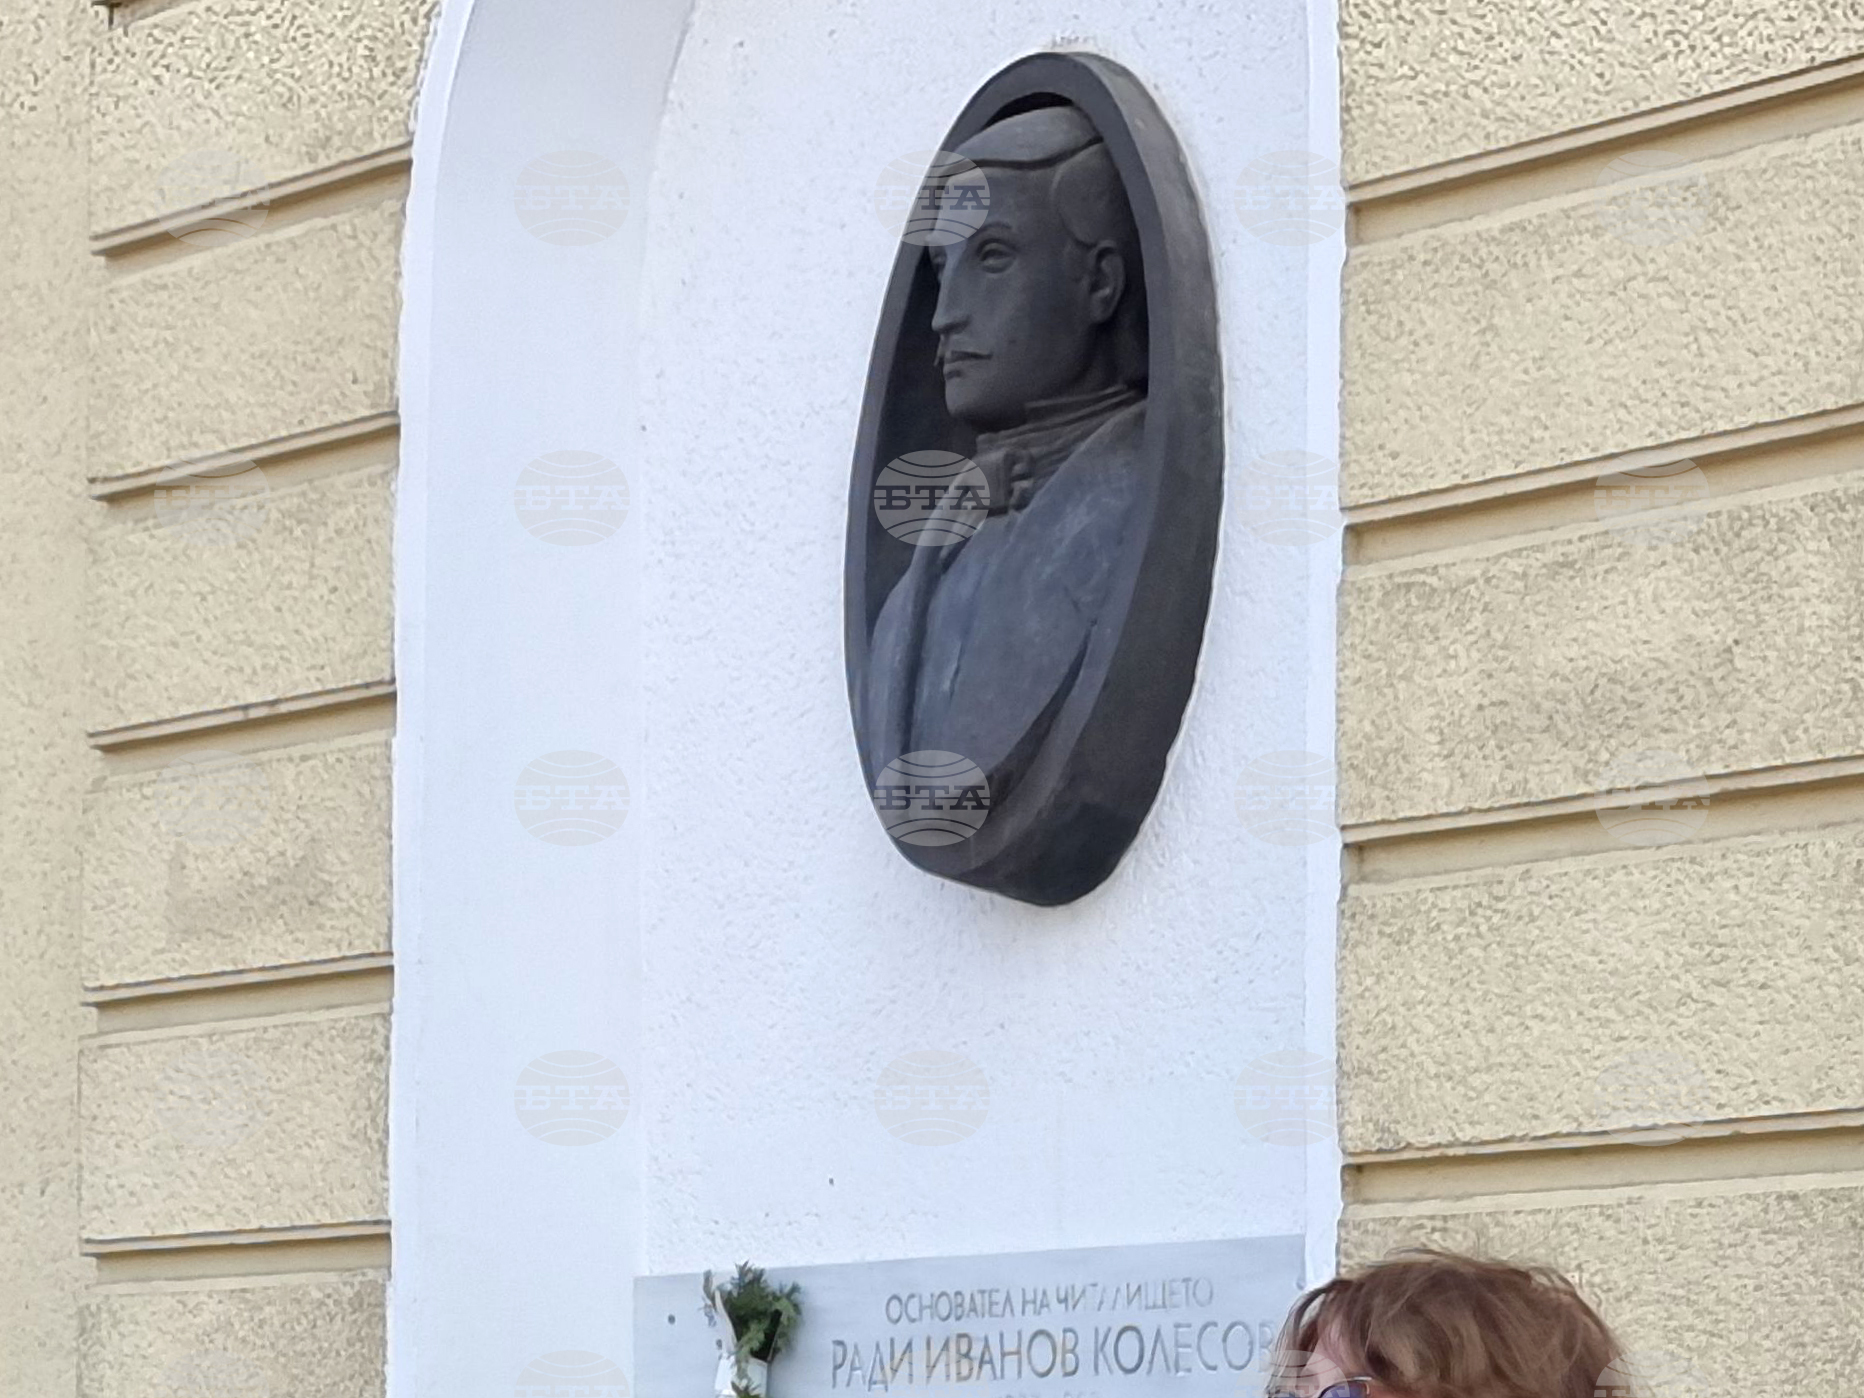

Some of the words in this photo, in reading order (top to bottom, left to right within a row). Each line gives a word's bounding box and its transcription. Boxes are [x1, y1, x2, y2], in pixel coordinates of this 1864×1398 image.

[885, 1288, 1015, 1325] ОСНОВАТЕЛ
[831, 1336, 914, 1392] РАДИ
[925, 1327, 1080, 1387] ИВАНОВ
[1092, 1319, 1274, 1378] КОЛЕСОВ
